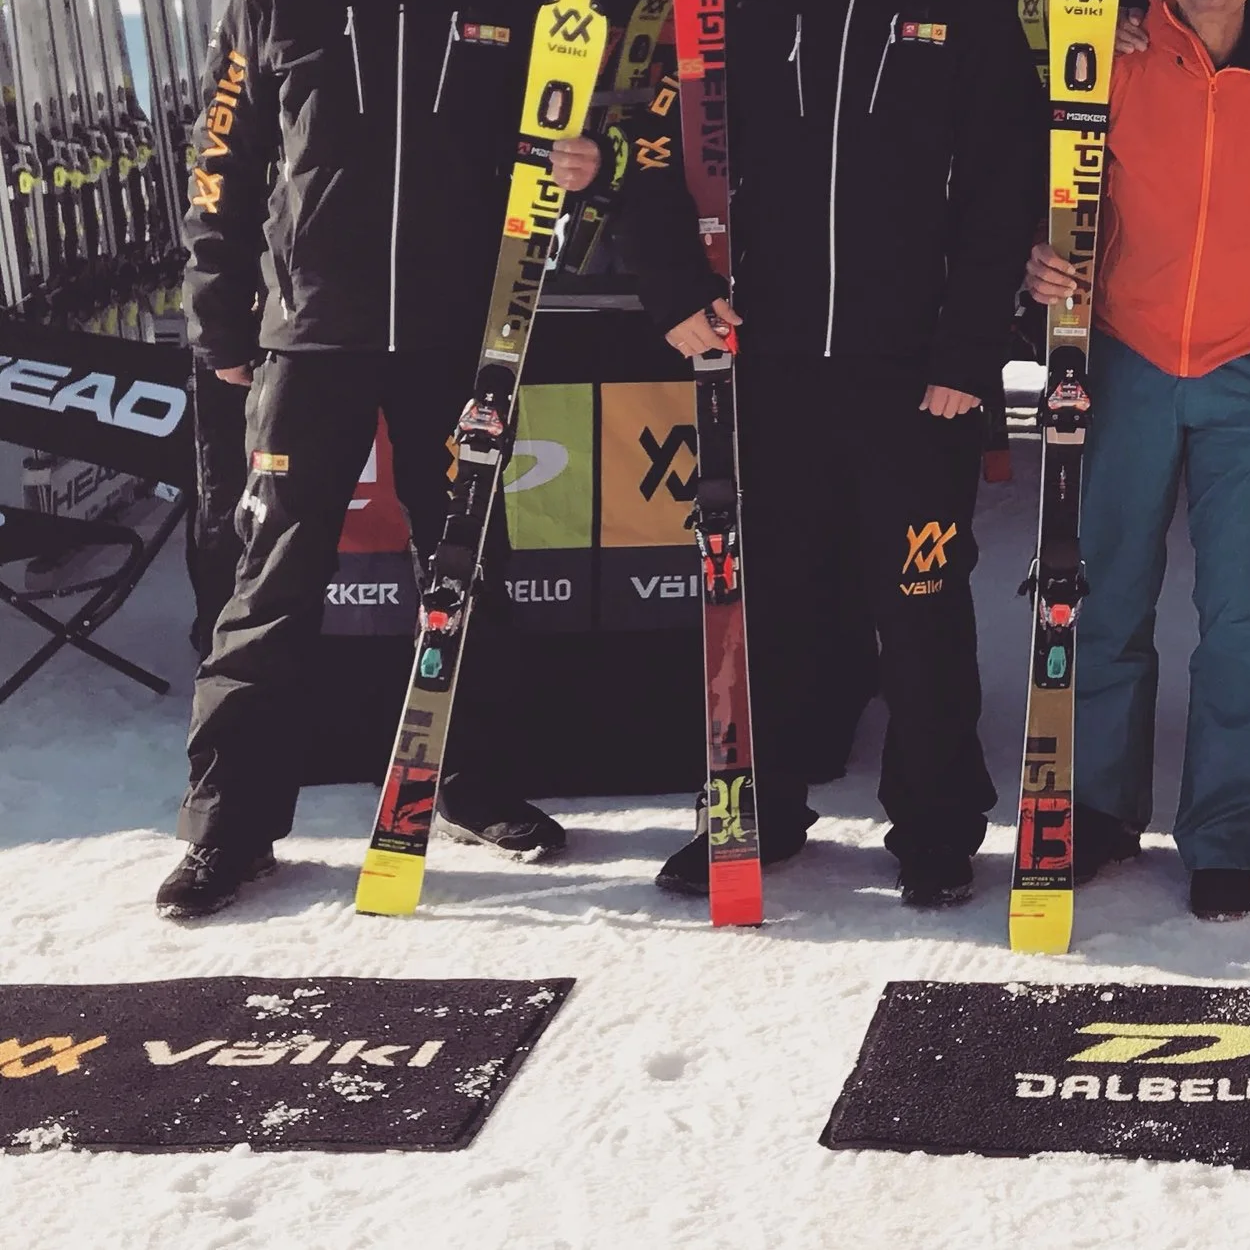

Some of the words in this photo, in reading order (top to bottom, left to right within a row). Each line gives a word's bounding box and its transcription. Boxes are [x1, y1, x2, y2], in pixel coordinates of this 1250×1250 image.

[1054, 189, 1076, 204] SL
[506, 219, 530, 235] SL
[0, 356, 187, 437] EAD
[325, 583, 399, 605] RKER
[630, 575, 697, 598] Völ
